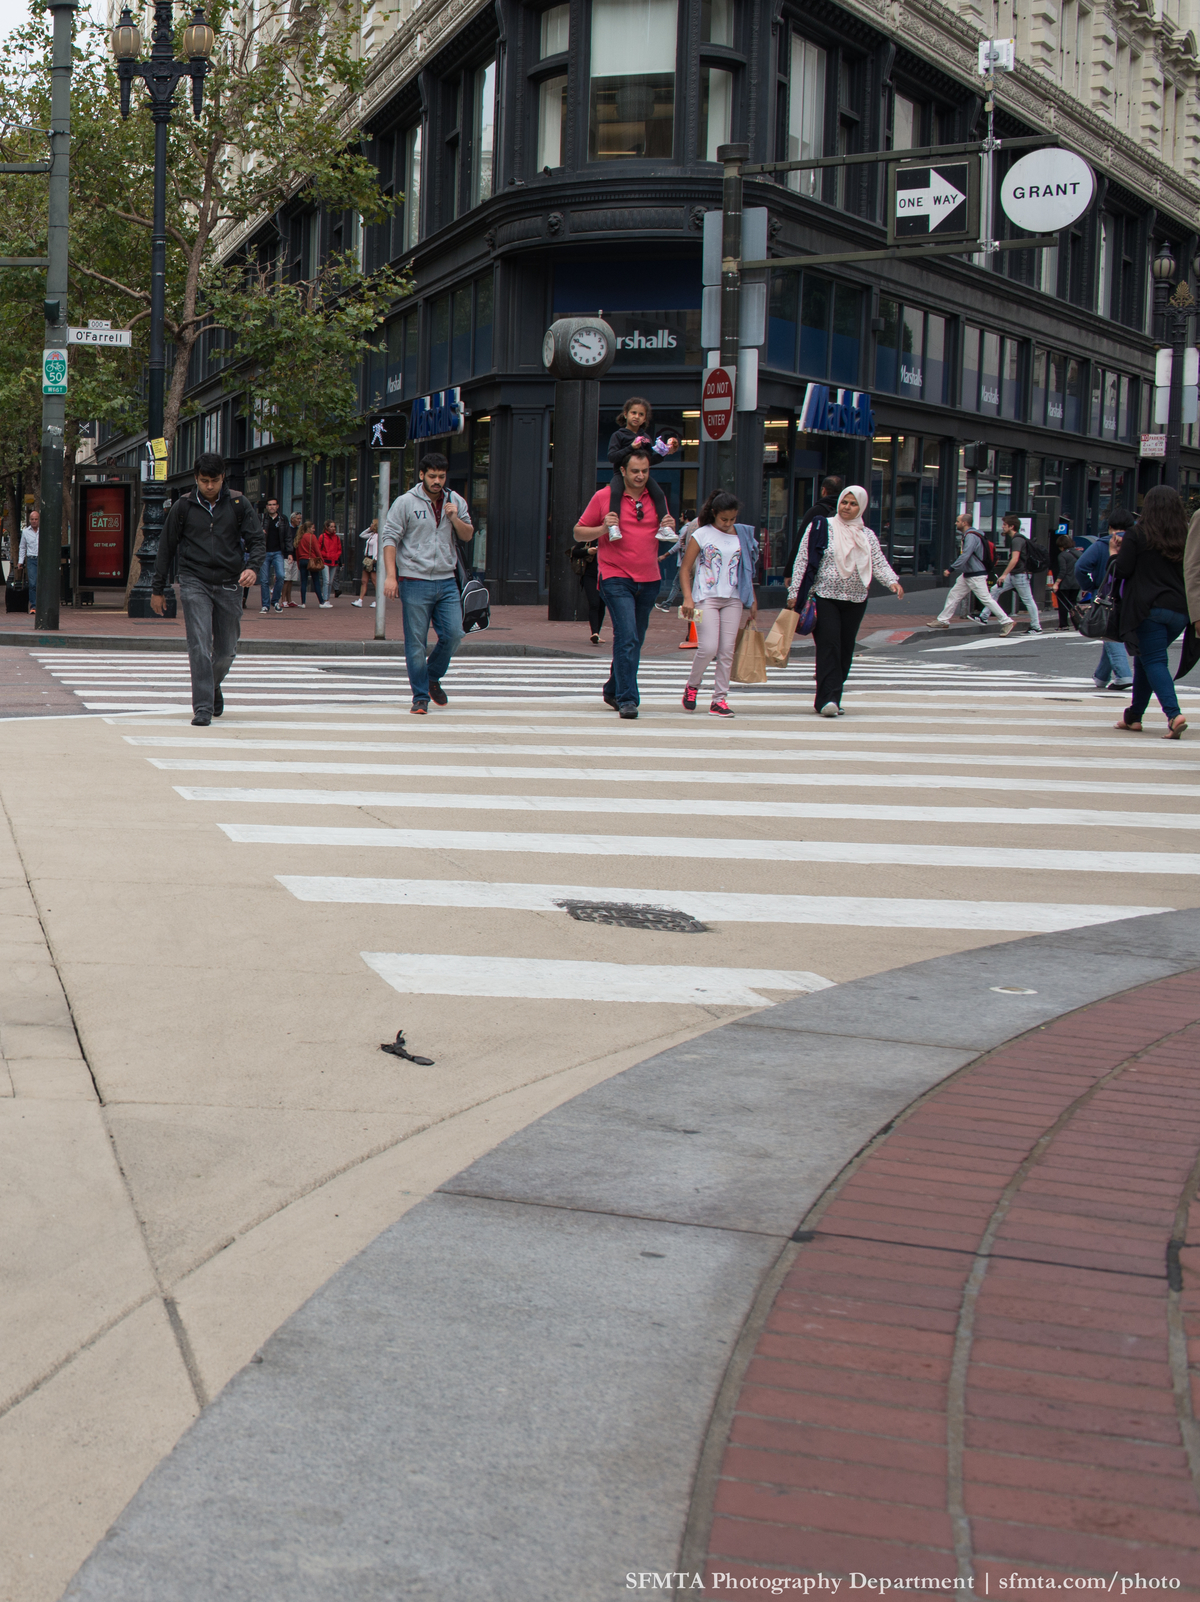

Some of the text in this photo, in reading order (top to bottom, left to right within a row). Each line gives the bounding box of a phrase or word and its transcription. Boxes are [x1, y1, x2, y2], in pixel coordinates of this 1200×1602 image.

[1012, 181, 1081, 200] GRANT
[898, 193, 959, 209] ONE WAY
[75, 330, 123, 343] O'Farrell
[49, 372, 63, 382] 50
[900, 364, 924, 388] Marshalls
[706, 381, 730, 395] DO NOT
[798, 383, 876, 438] Marshalls
[707, 414, 726, 427] ENTER
[413, 509, 428, 520] VI
[91, 517, 120, 528] EAT24
